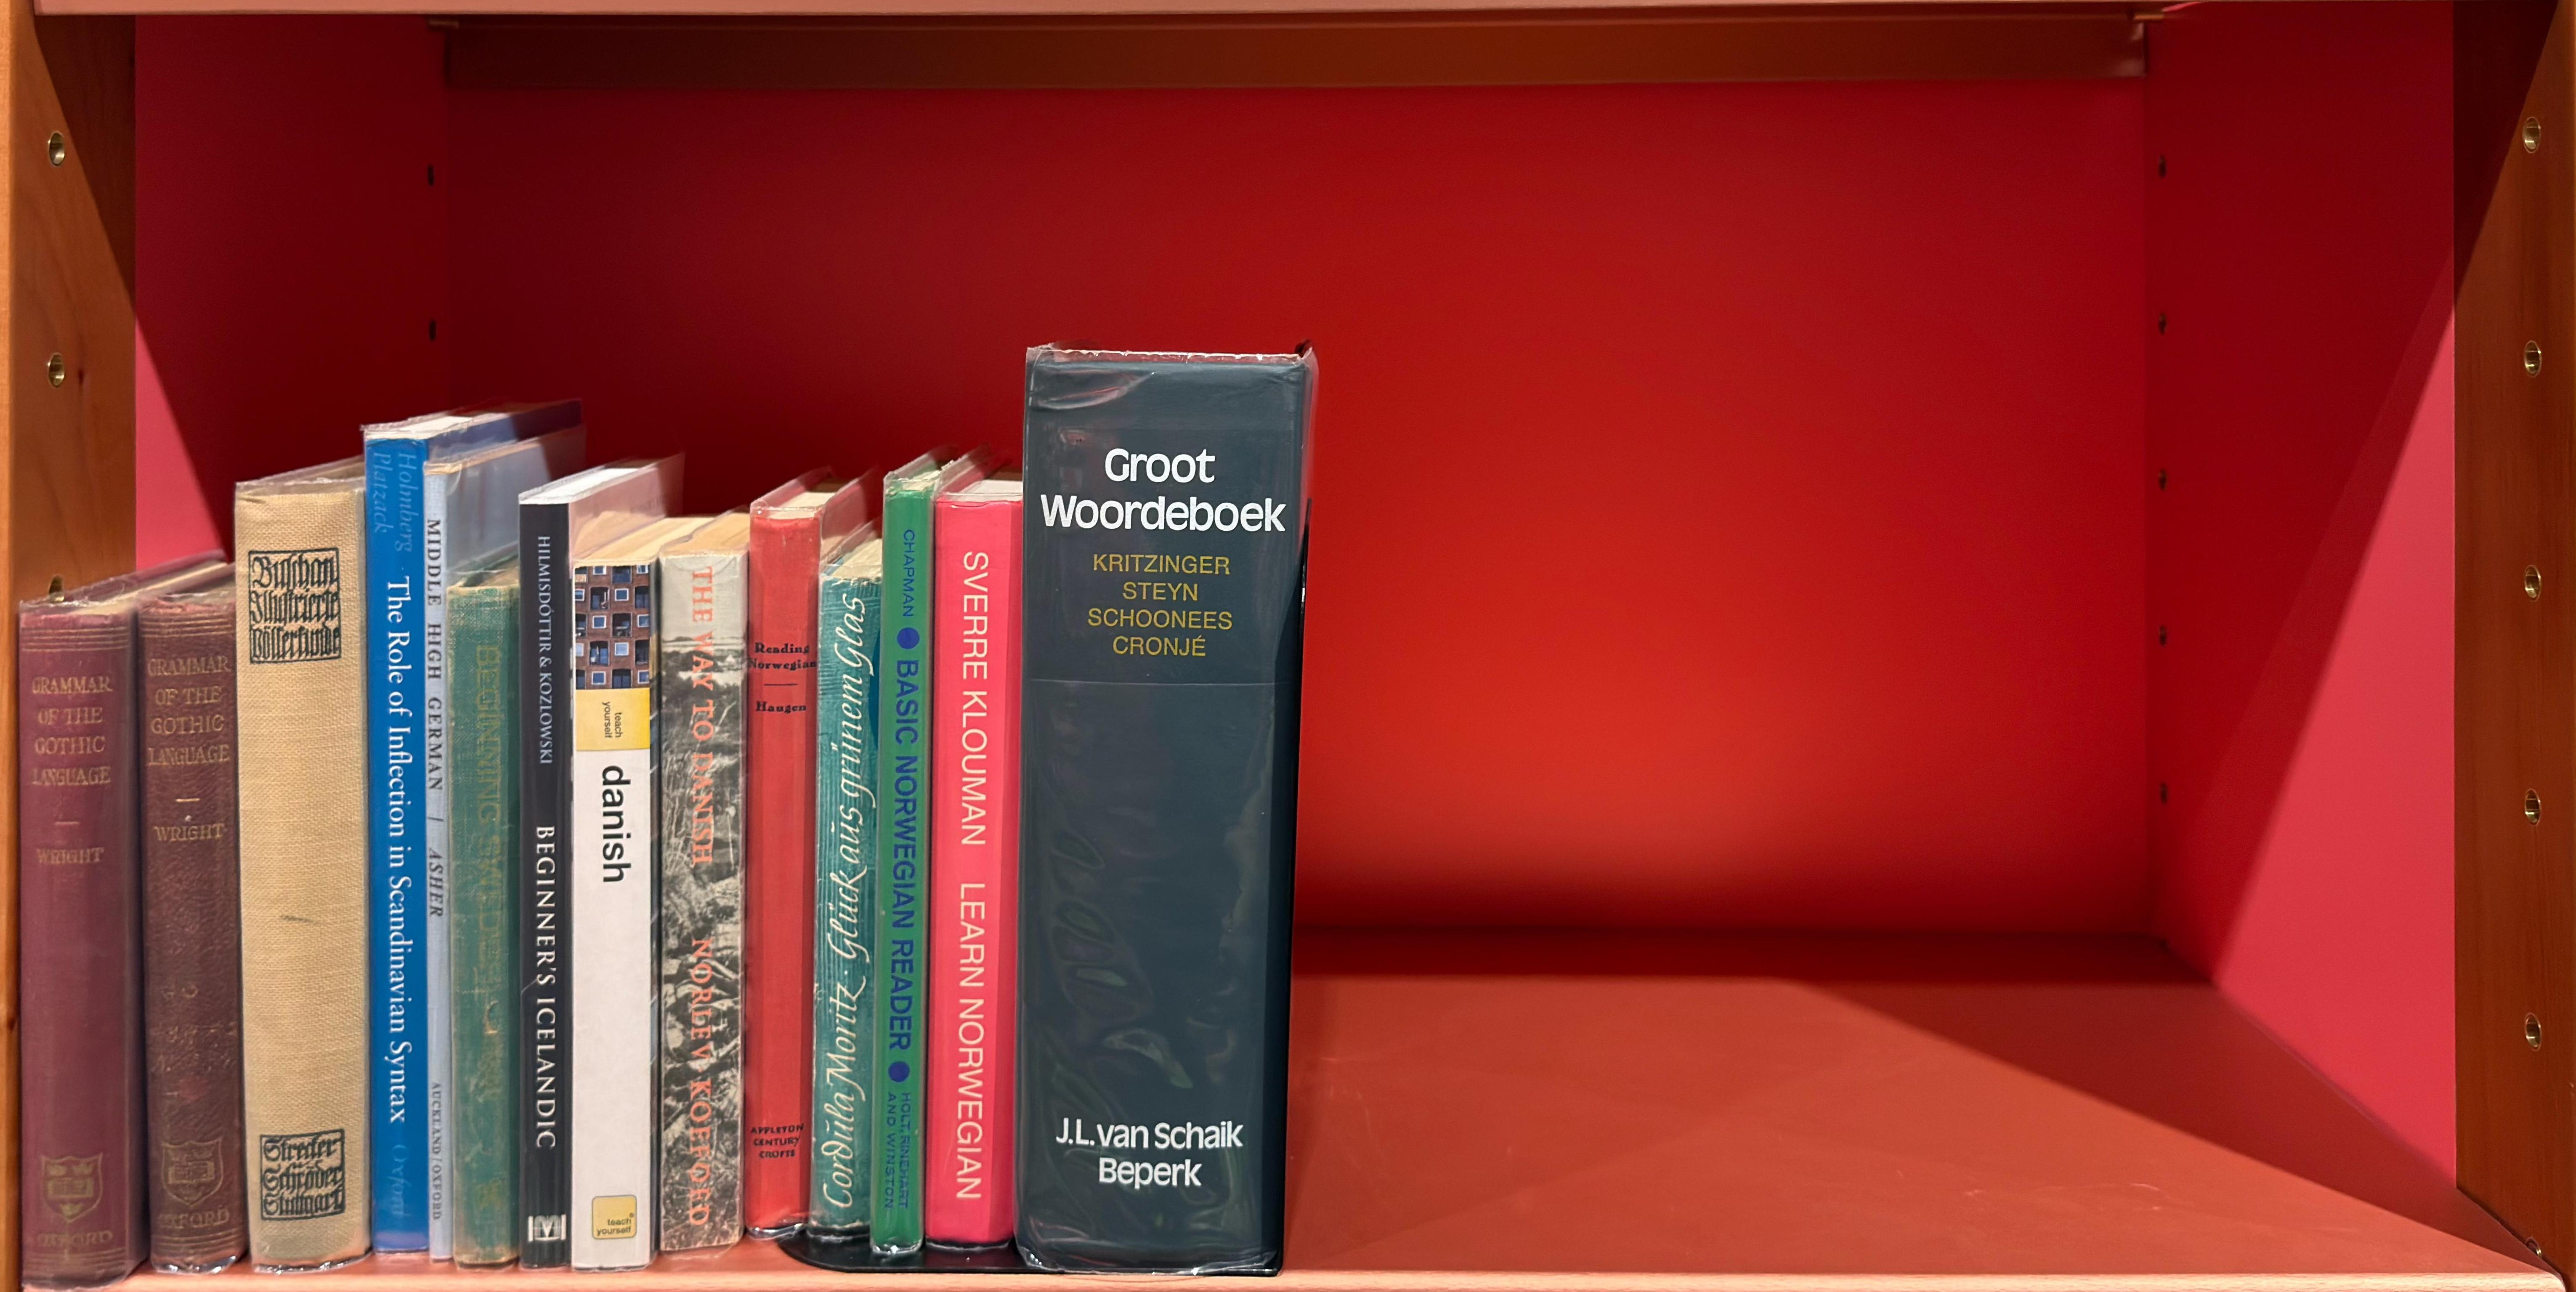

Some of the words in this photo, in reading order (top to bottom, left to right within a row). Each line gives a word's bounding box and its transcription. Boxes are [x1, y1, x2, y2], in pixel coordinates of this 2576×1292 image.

[374, 452, 394, 533] Platzack
[1105, 448, 1215, 484] Groot
[394, 453, 419, 553] Holmberg
[1041, 494, 1286, 532] Woordeboek
[428, 520, 441, 606] MIDDLE
[903, 530, 916, 617] CHAPMAN
[1093, 553, 1230, 575] KRITZINGER
[388, 576, 412, 623] The
[537, 537, 554, 652] HILMISDÓTTIR
[693, 566, 713, 622] THE
[963, 551, 988, 680] SVERRE
[1088, 608, 1232, 630] SCHOONEES
[1123, 582, 1198, 601] STEYN
[388, 631, 412, 684] Role
[428, 624, 441, 679] HIGH
[539, 657, 551, 667] &
[692, 631, 714, 690] WAY
[755, 642, 810, 654] Reading
[834, 593, 874, 676] Glas
[1113, 634, 1206, 657] CRONJÉ
[32, 676, 112, 694] GRAMMAR
[148, 656, 231, 676] GRAMMAR
[748, 657, 817, 671] Norwegian
[38, 708, 59, 725] OF
[64, 707, 103, 723] THE
[156, 689, 179, 705] OF
[183, 686, 222, 704] THE
[389, 697, 413, 717] of
[540, 673, 552, 764] KOZLOWSKI
[602, 702, 612, 738] yourself
[692, 701, 714, 742] TO
[755, 701, 807, 713] Haugen
[895, 660, 919, 744] BASIC
[35, 736, 105, 755] GOTHIC
[151, 715, 224, 734] GOTHIC
[428, 697, 443, 790] GERMAN
[615, 712, 624, 738] teach
[830, 673, 876, 808] grünem
[32, 766, 111, 786] LANGUAGE
[148, 744, 230, 766] LANGUAGE
[389, 727, 413, 837] Inflection
[961, 691, 987, 845] KLOUMAN
[154, 822, 226, 841] WRIGHT
[602, 765, 631, 882] danish
[692, 752, 714, 864] DANISH
[37, 847, 104, 864] WRIGHT
[390, 846, 411, 867] in
[892, 756, 917, 929] NORWEGIAN
[429, 848, 443, 917] ASHER
[536, 827, 556, 986] BEGINNER'S
[828, 866, 870, 962] Glück
[959, 883, 985, 987] LEARN
[390, 876, 413, 1033] Scandinavian
[691, 938, 713, 1060] NORLEV
[889, 939, 914, 1050] READER
[826, 976, 866, 1101] Moritz
[385, 1041, 412, 1123] Syntax
[536, 999, 556, 1148] ICELANDIC
[956, 999, 984, 1199] NORWEGIAN
[432, 1082, 441, 1154] AUCKLAND
[751, 1123, 804, 1134] APPLETON
[887, 1092, 896, 1126] AND
[1155, 1120, 1243, 1149] Schaik
[689, 1080, 712, 1226] KOEFOED
[754, 1137, 799, 1146] CENTURY
[432, 1164, 442, 1220] OXFORD
[884, 1133, 895, 1209] WINSTON
[898, 1135, 910, 1208] RINEHART
[1099, 1157, 1202, 1189] Beperk
[607, 1217, 631, 1226] teach
